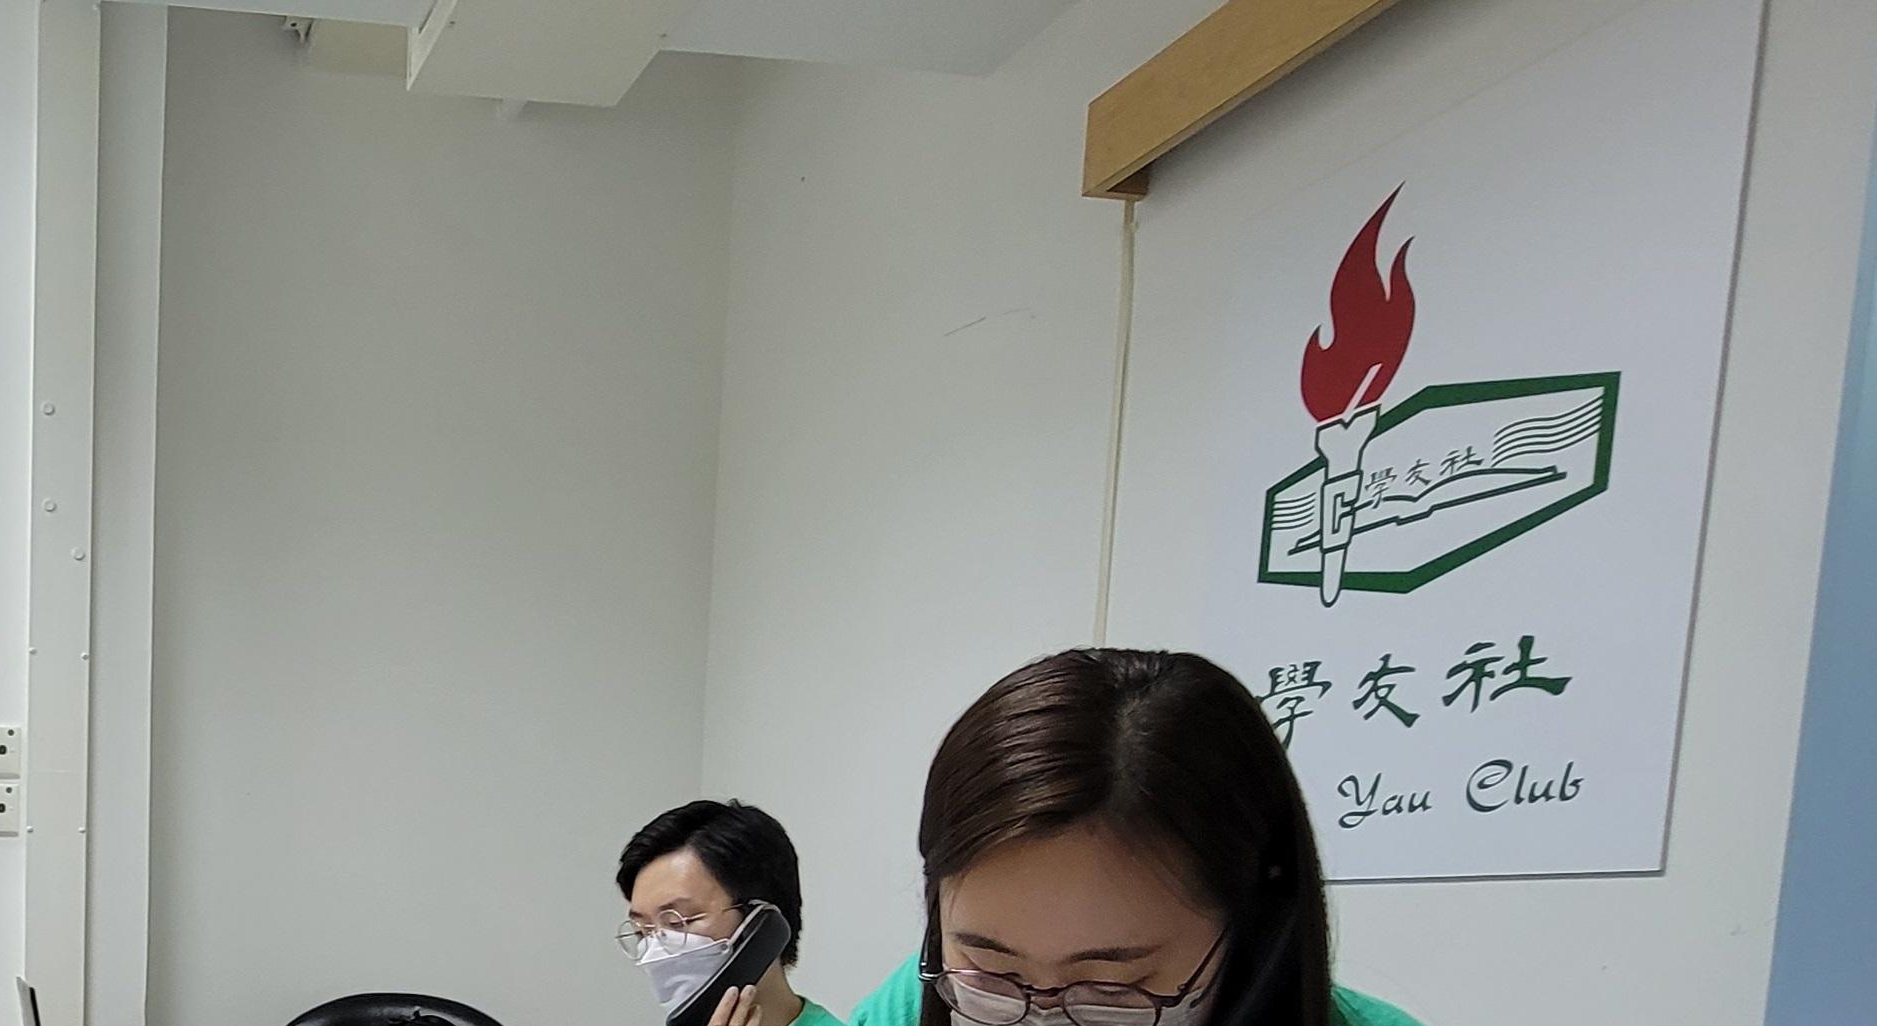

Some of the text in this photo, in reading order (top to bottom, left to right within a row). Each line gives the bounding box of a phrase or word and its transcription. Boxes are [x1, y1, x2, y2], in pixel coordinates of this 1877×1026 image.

[1364, 448, 1485, 509] 學友社
[1260, 634, 1574, 749] 學友社
[1337, 758, 1585, 830] Yau Club
